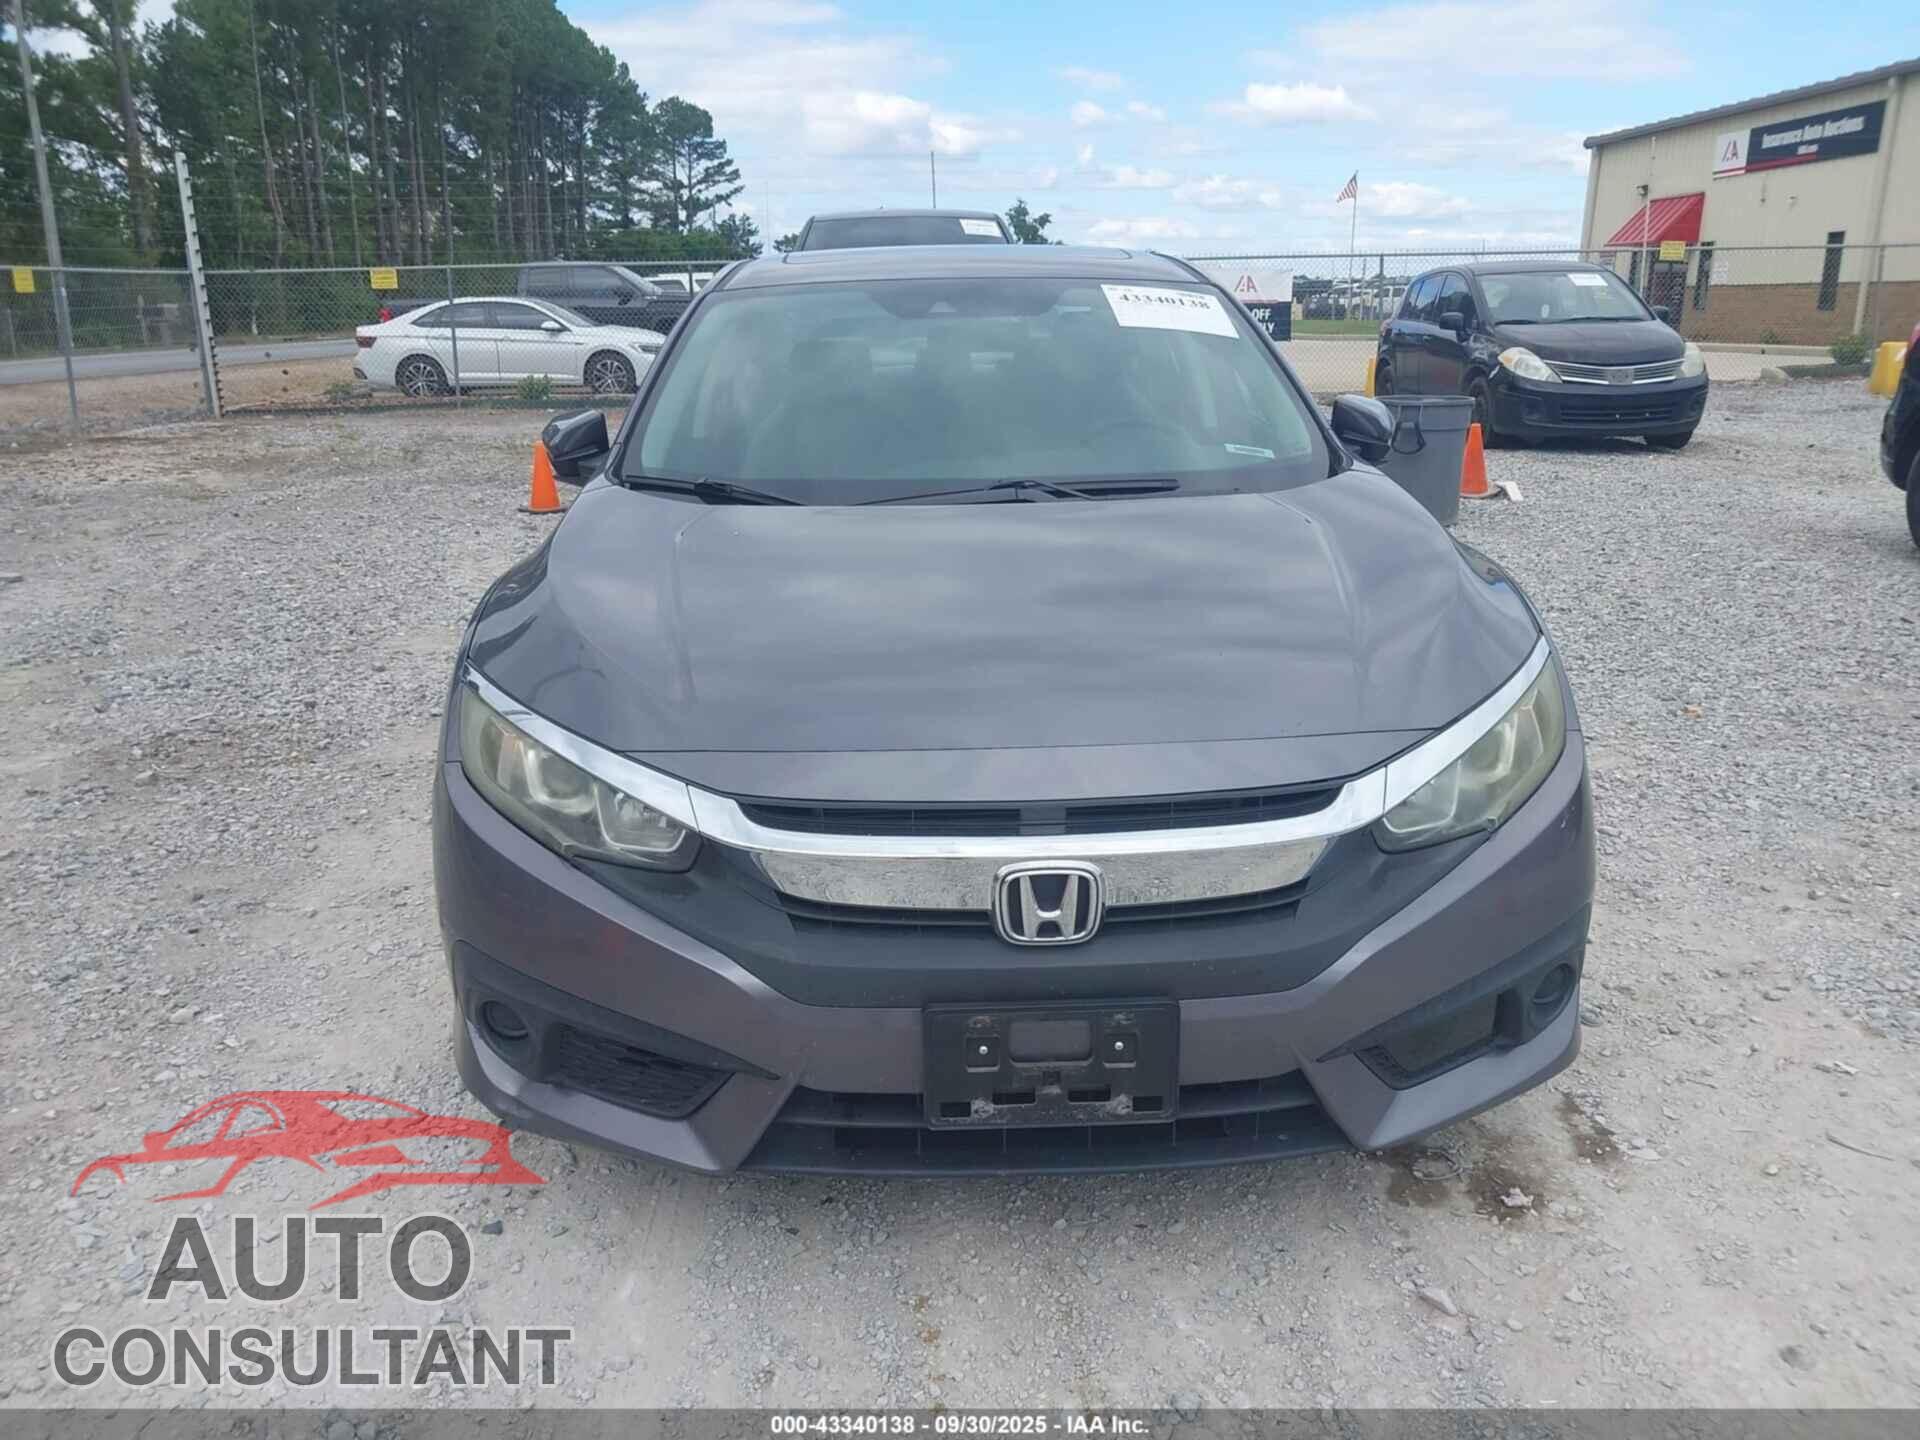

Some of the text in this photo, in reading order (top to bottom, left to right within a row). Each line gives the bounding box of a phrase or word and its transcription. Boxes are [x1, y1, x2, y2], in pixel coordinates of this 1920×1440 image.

[1803, 124, 1823, 141] Auto
[1823, 116, 1865, 137] Auctions
[1251, 308, 1272, 321] OFF
